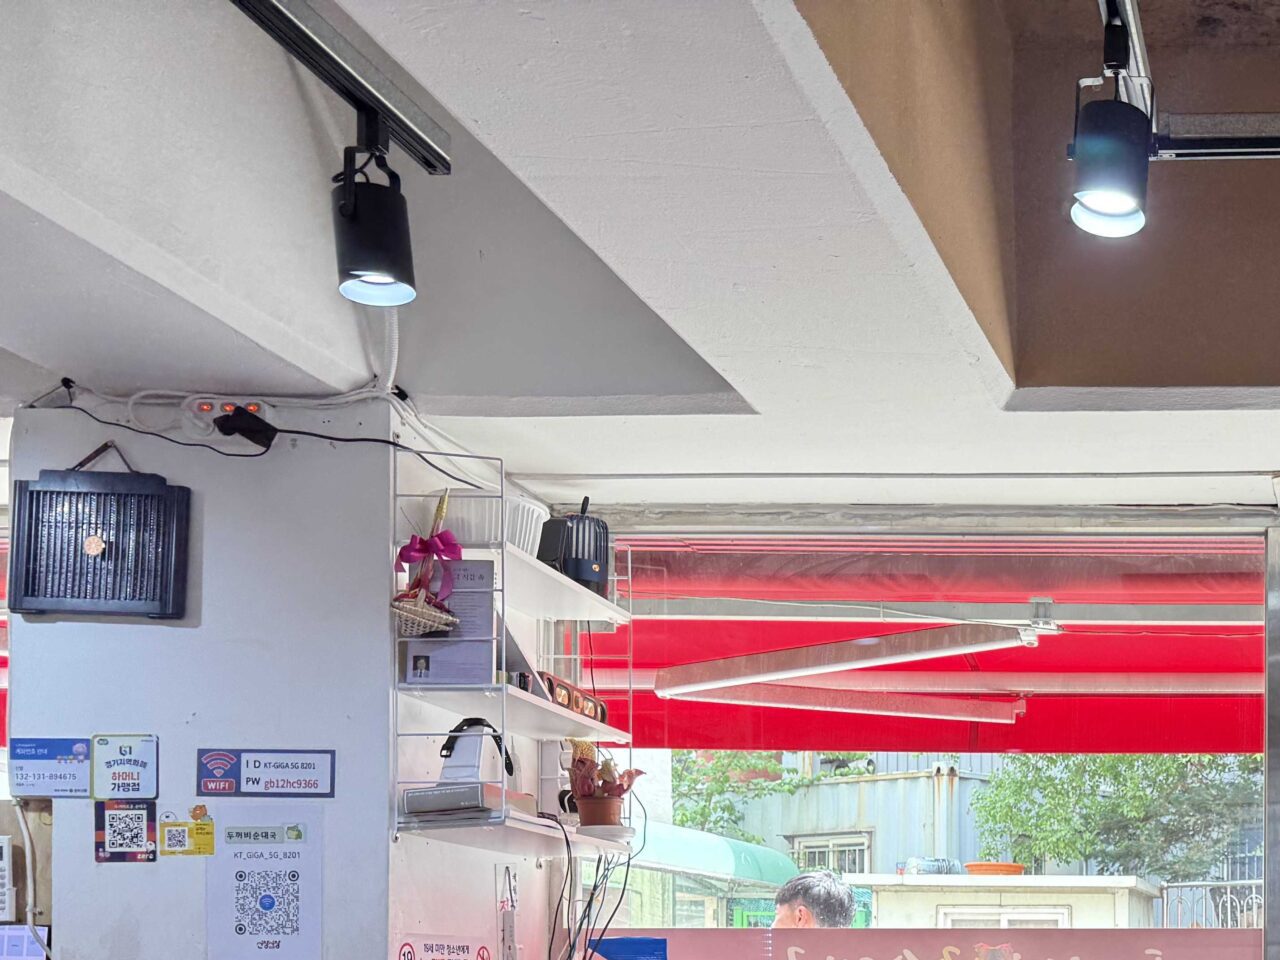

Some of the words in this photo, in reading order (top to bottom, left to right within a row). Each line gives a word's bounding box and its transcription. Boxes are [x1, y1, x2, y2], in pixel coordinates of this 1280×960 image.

[104, 758, 148, 769] 경기지역화폐
[300, 762, 316, 770] 8201
[112, 771, 140, 781] 하머니
[111, 782, 140, 793] 가맹점
[207, 781, 229, 790] WIFI
[246, 777, 261, 785] PW
[264, 779, 319, 790] gb12hc9366
[227, 831, 277, 840] 두꺼비순대국
[435, 944, 445, 954] 미만
[446, 944, 470, 955] 청소년에게
